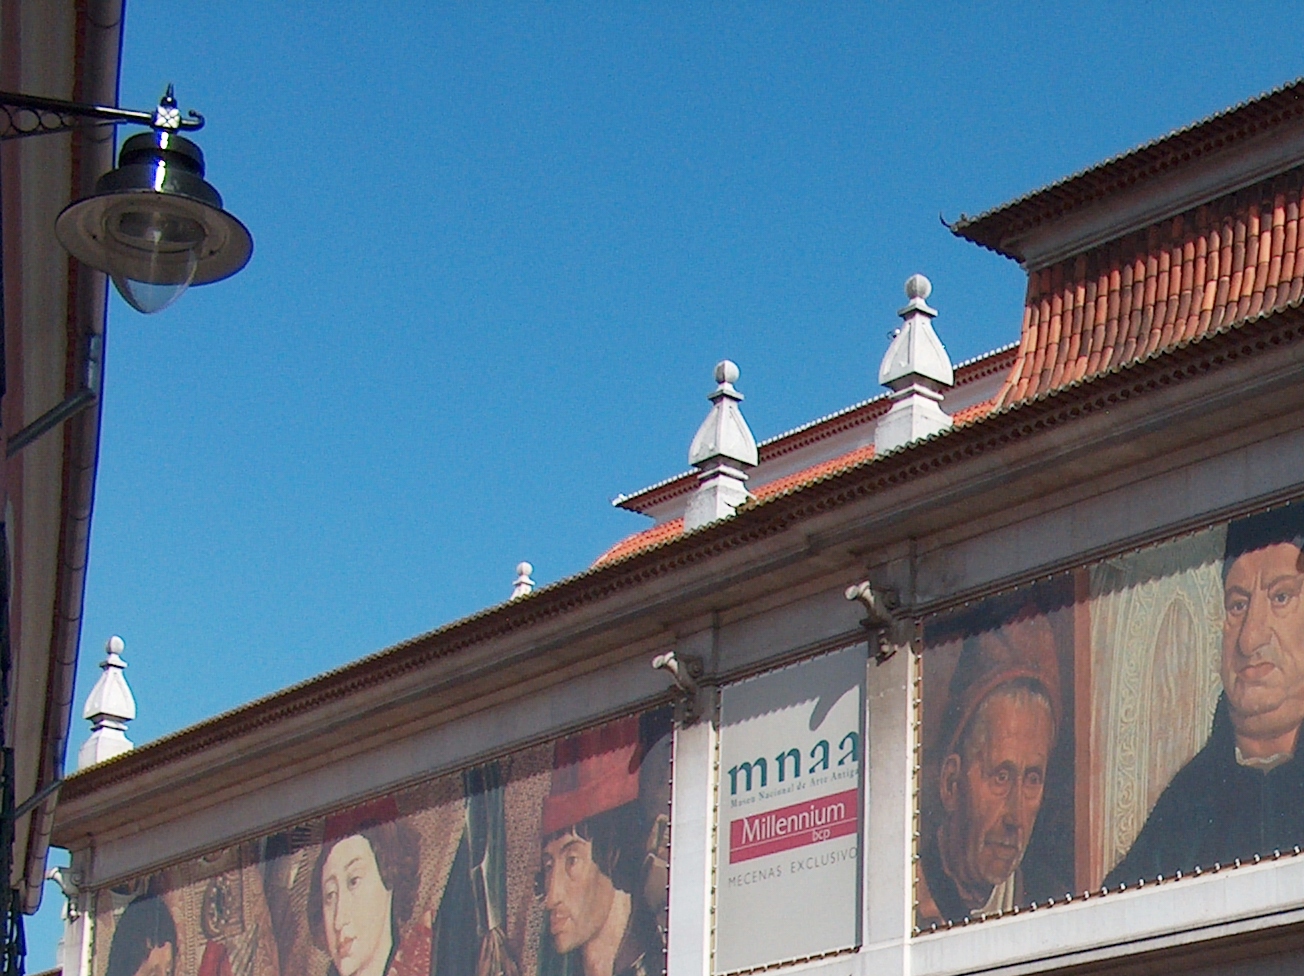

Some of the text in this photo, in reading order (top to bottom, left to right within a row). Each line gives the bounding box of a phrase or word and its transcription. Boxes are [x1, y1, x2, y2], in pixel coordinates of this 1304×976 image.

[727, 731, 859, 796] mnaa
[730, 796, 756, 809] Museu
[759, 784, 795, 800] Nacional
[797, 781, 807, 791] de
[810, 776, 828, 788] Arte
[741, 802, 846, 844] Millennium
[812, 827, 831, 843] bcp
[727, 847, 858, 889] MECENAS EXCLUSIVO
